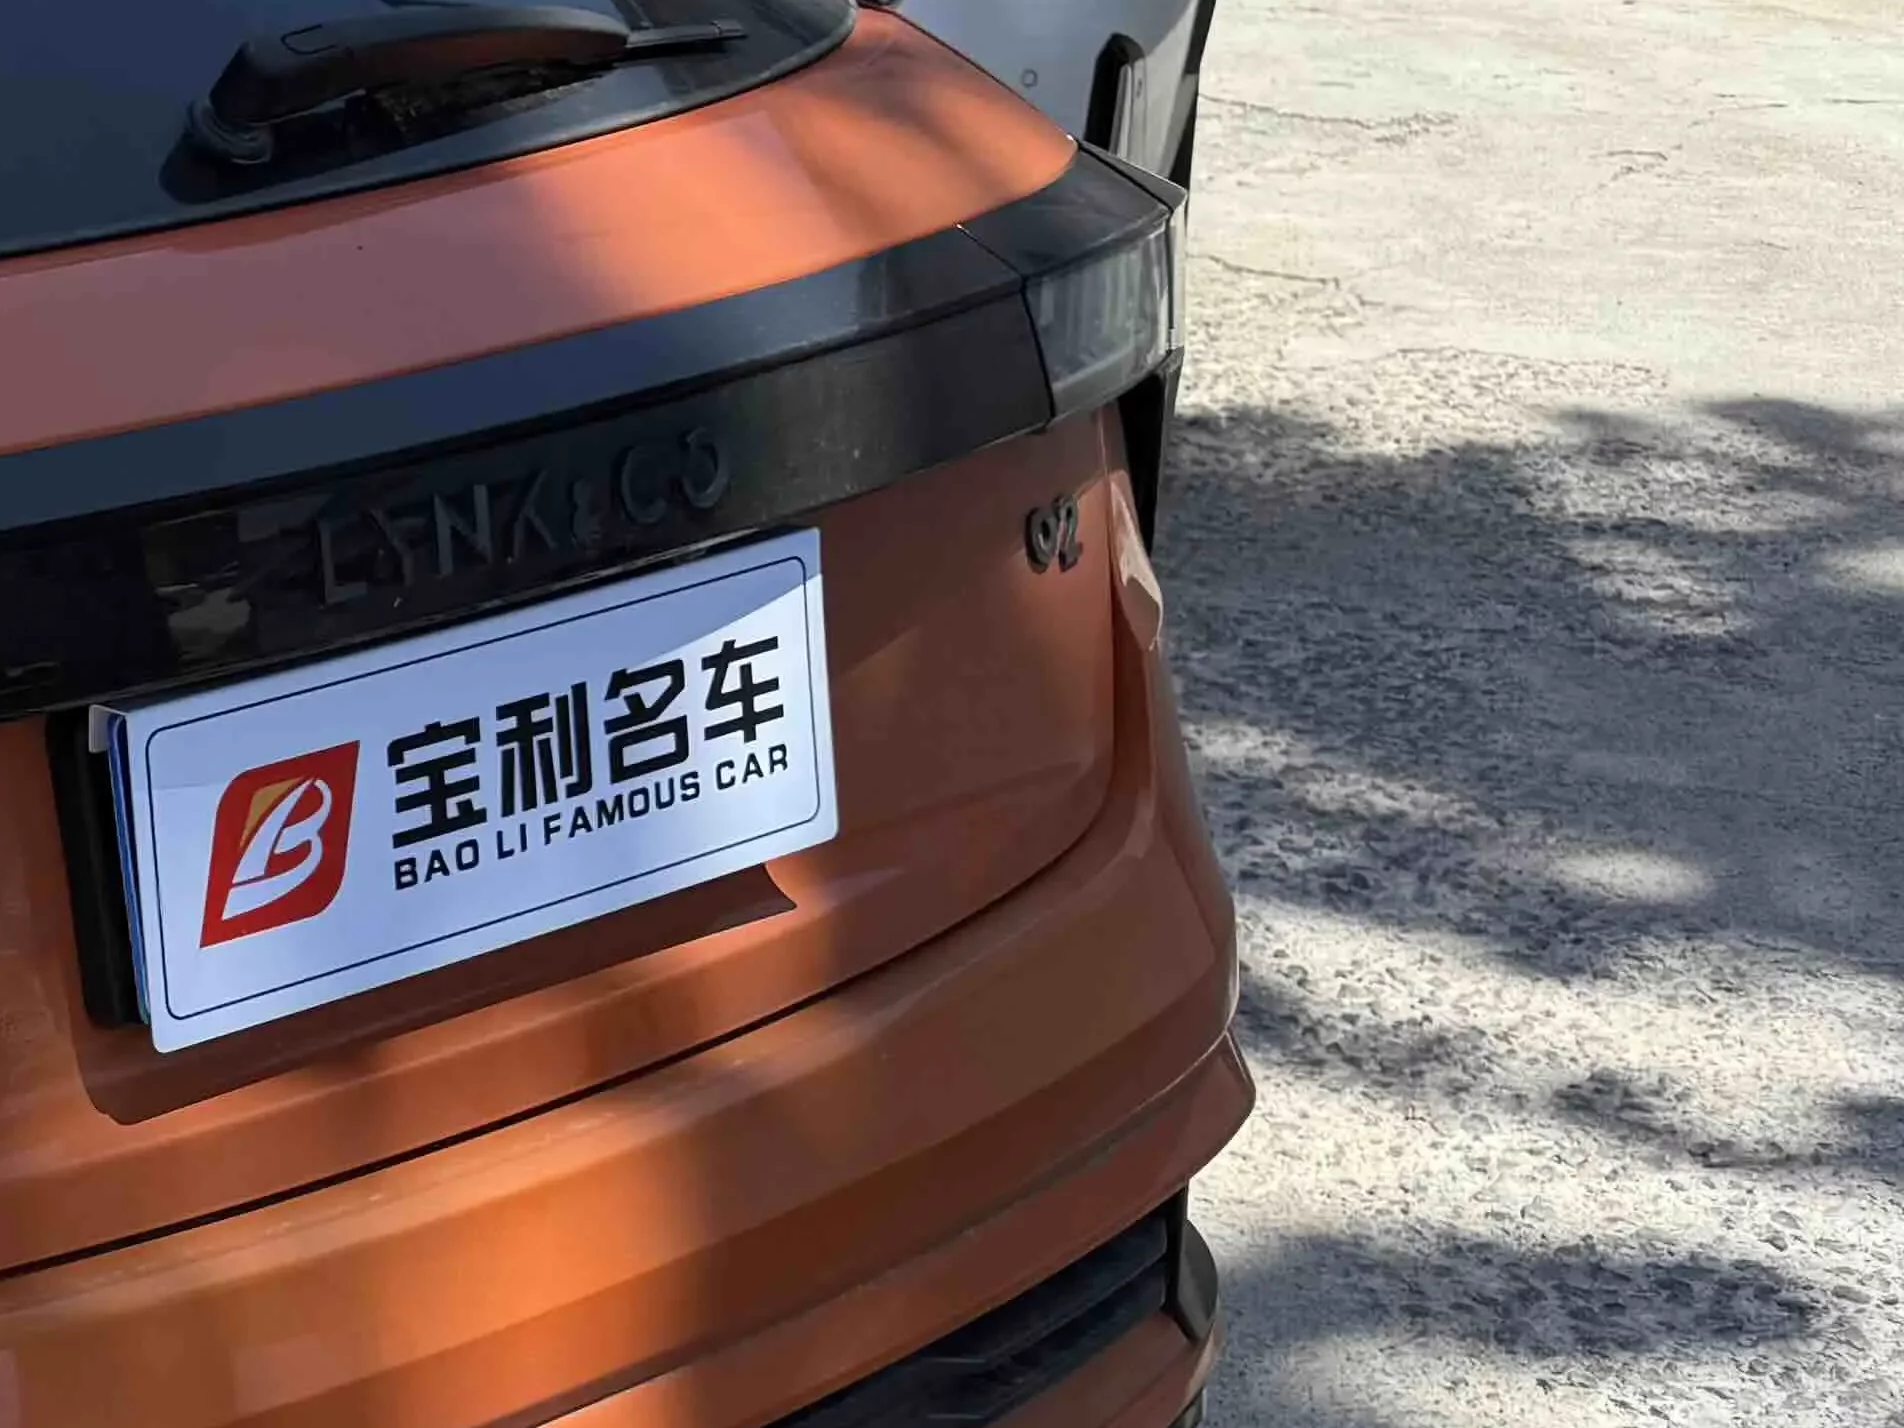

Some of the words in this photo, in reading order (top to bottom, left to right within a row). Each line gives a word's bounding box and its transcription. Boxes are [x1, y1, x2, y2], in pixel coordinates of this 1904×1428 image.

[1024, 496, 1083, 575] 02
[387, 636, 785, 849] 宝利名车
[394, 838, 480, 890] BAO
[496, 823, 528, 860] LI
[543, 771, 700, 845] FAMOUS
[715, 743, 789, 790] CAR
